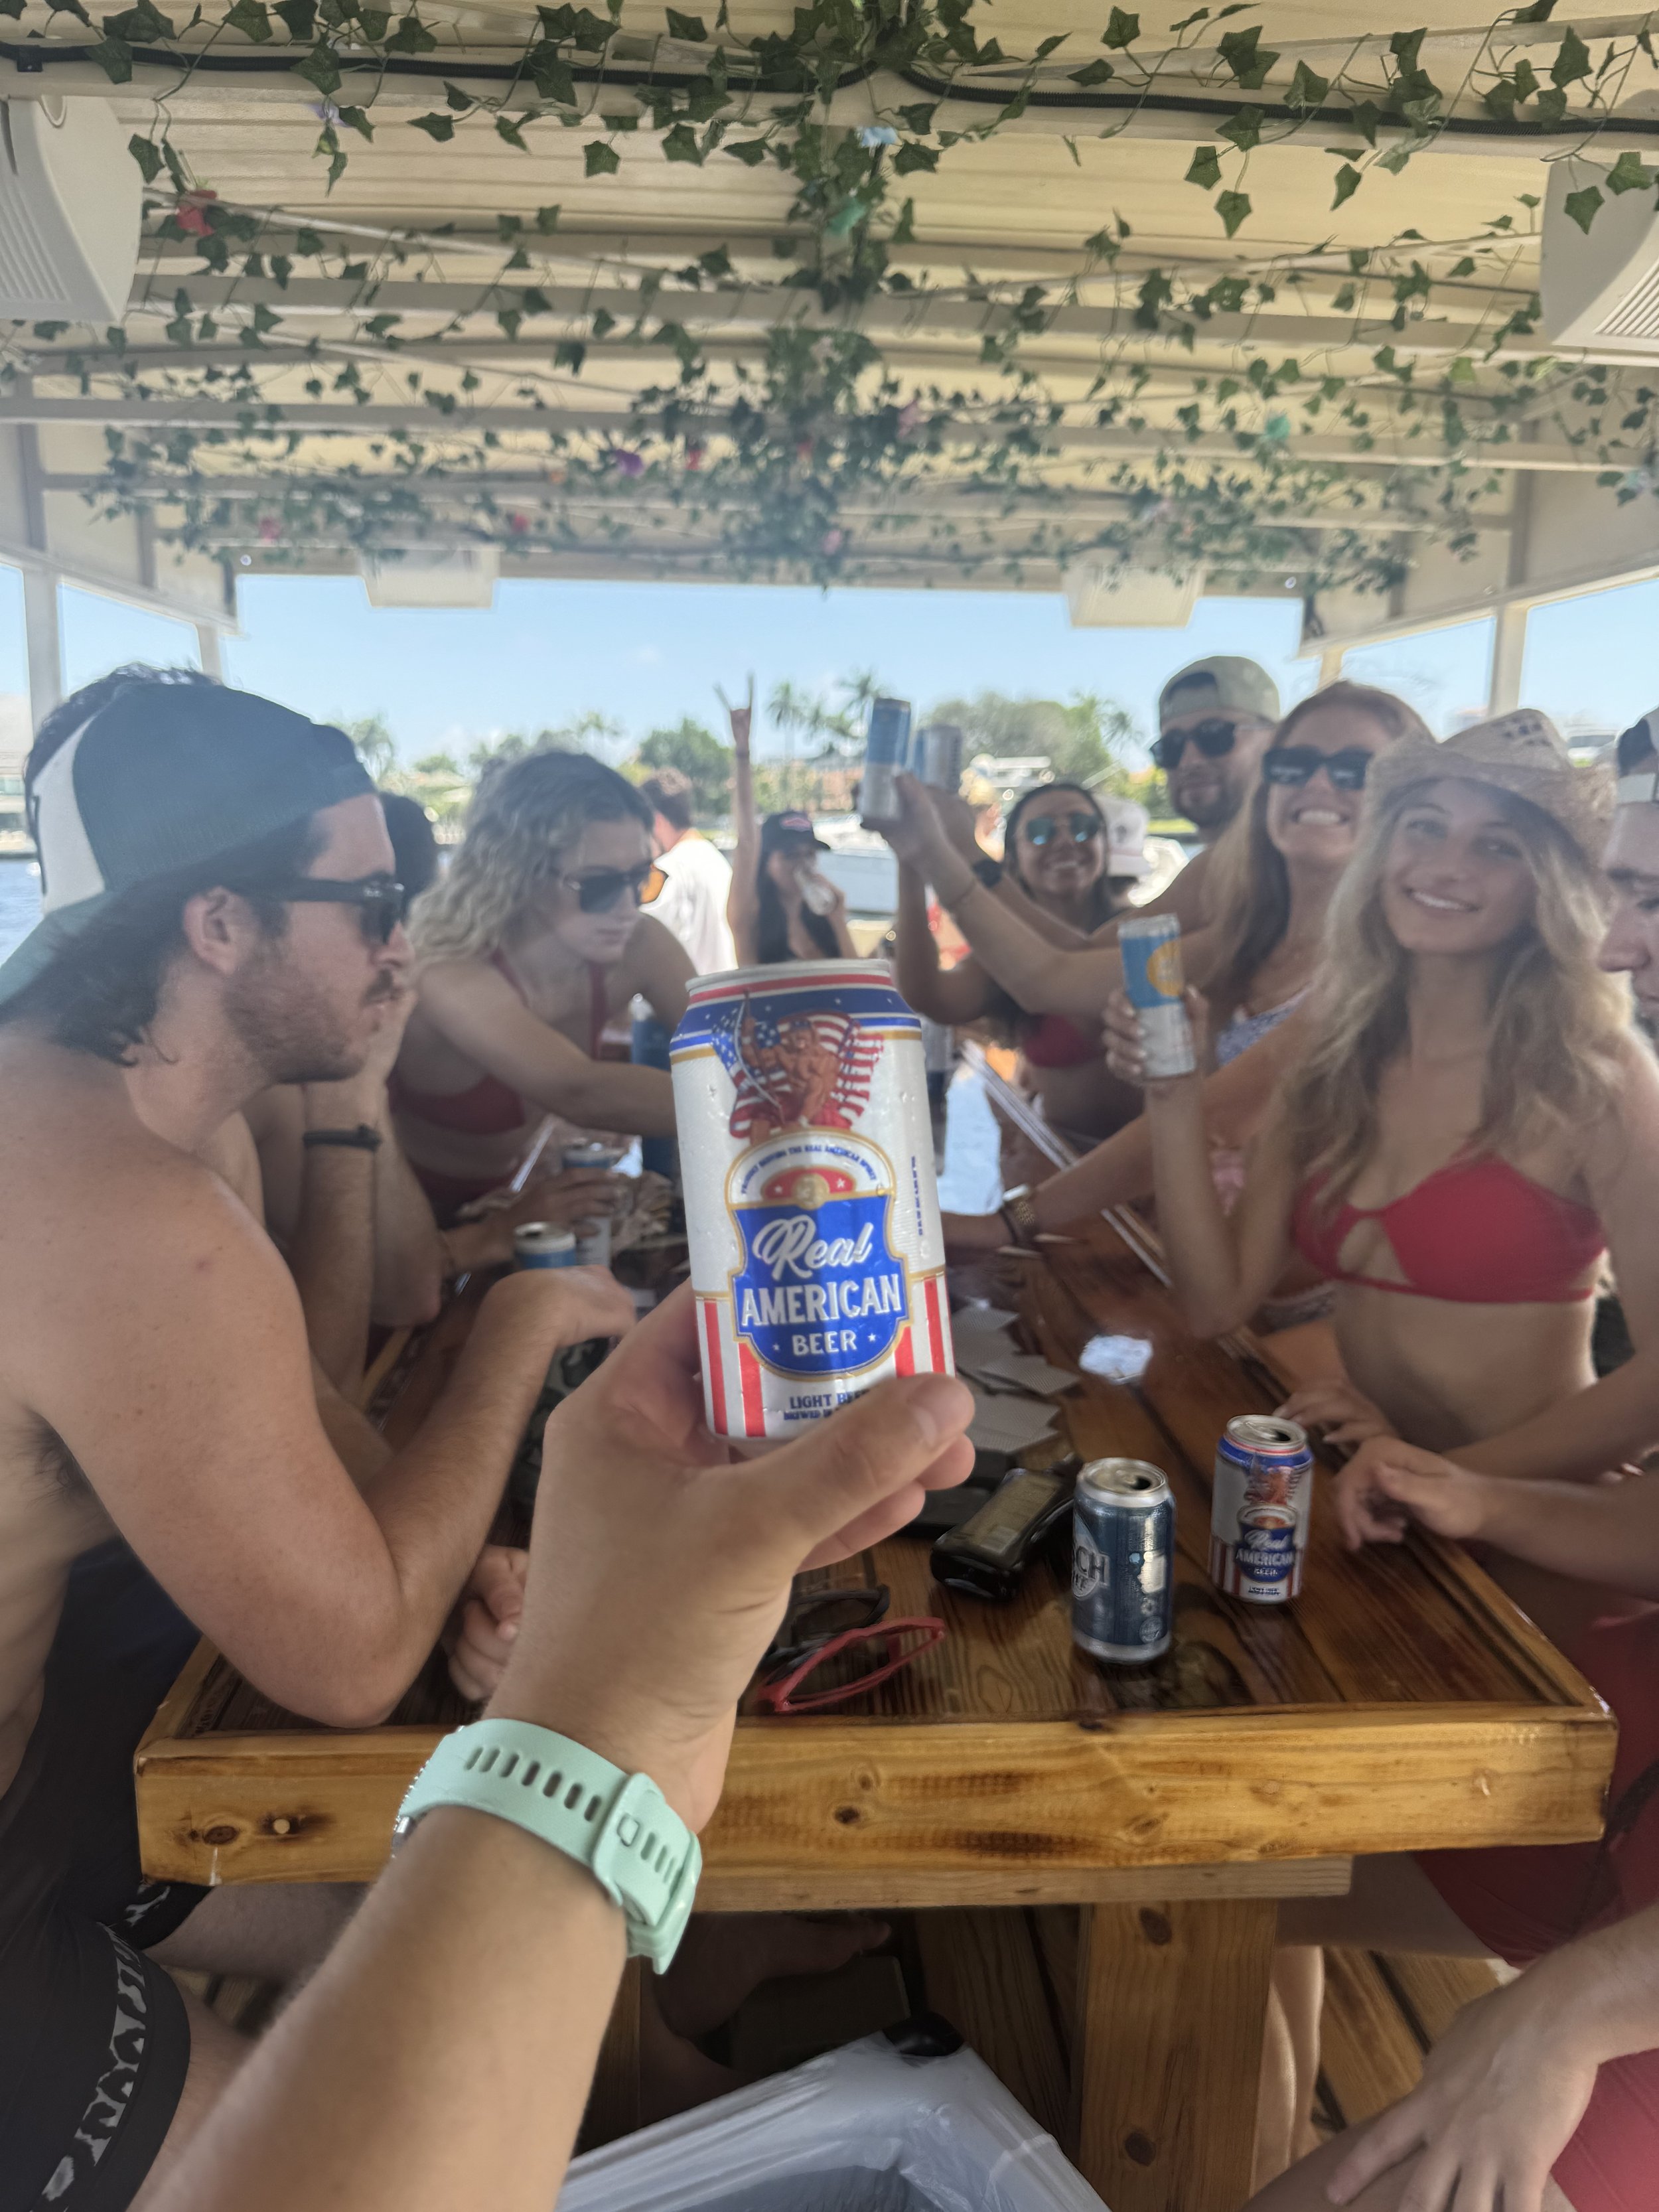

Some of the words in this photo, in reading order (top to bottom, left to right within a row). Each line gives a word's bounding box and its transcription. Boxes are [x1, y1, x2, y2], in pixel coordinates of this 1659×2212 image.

[752, 1215, 874, 1281] Real
[742, 1273, 902, 1327] AMERICAN
[792, 1329, 857, 1356] BEER
[790, 1394, 832, 1409] LIGHT
[1236, 1547, 1295, 1567] AMERICAN
